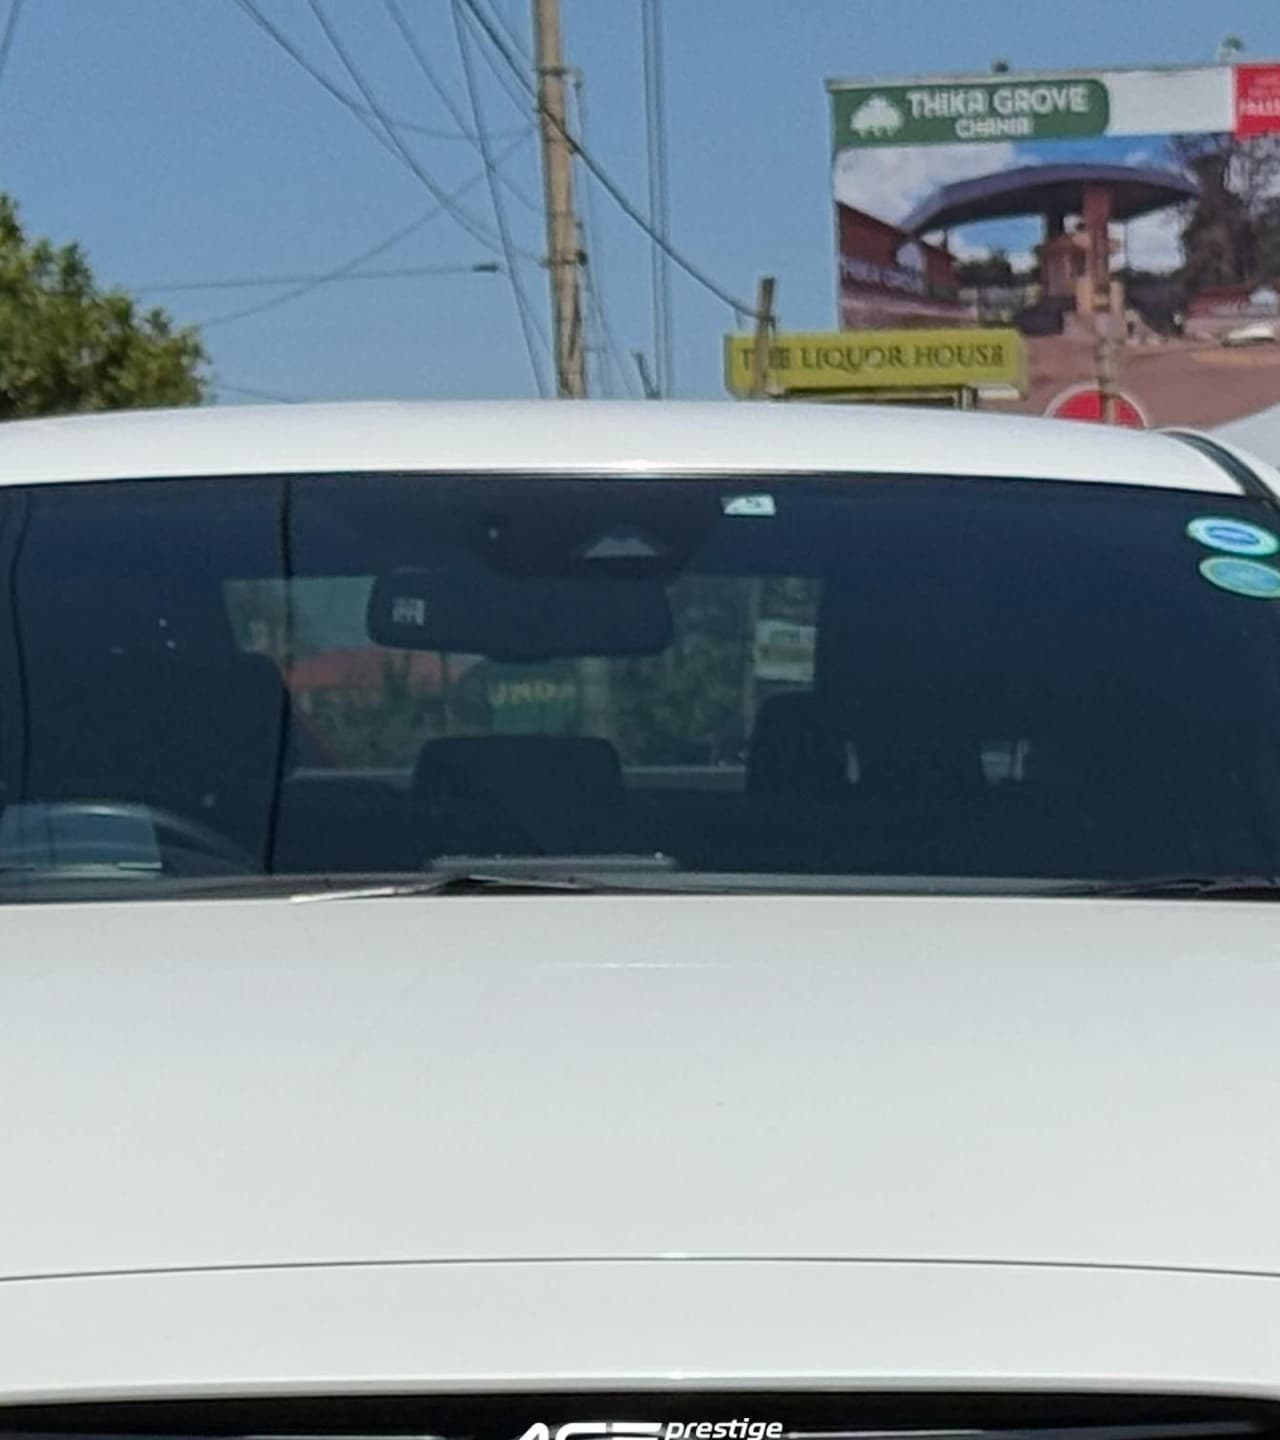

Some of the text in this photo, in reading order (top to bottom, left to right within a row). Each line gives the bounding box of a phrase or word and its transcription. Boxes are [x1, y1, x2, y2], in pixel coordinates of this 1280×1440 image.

[906, 86, 1089, 119] THIKA GROVE
[801, 345, 903, 373] LIQUOR
[914, 343, 1005, 368] HOUSE
